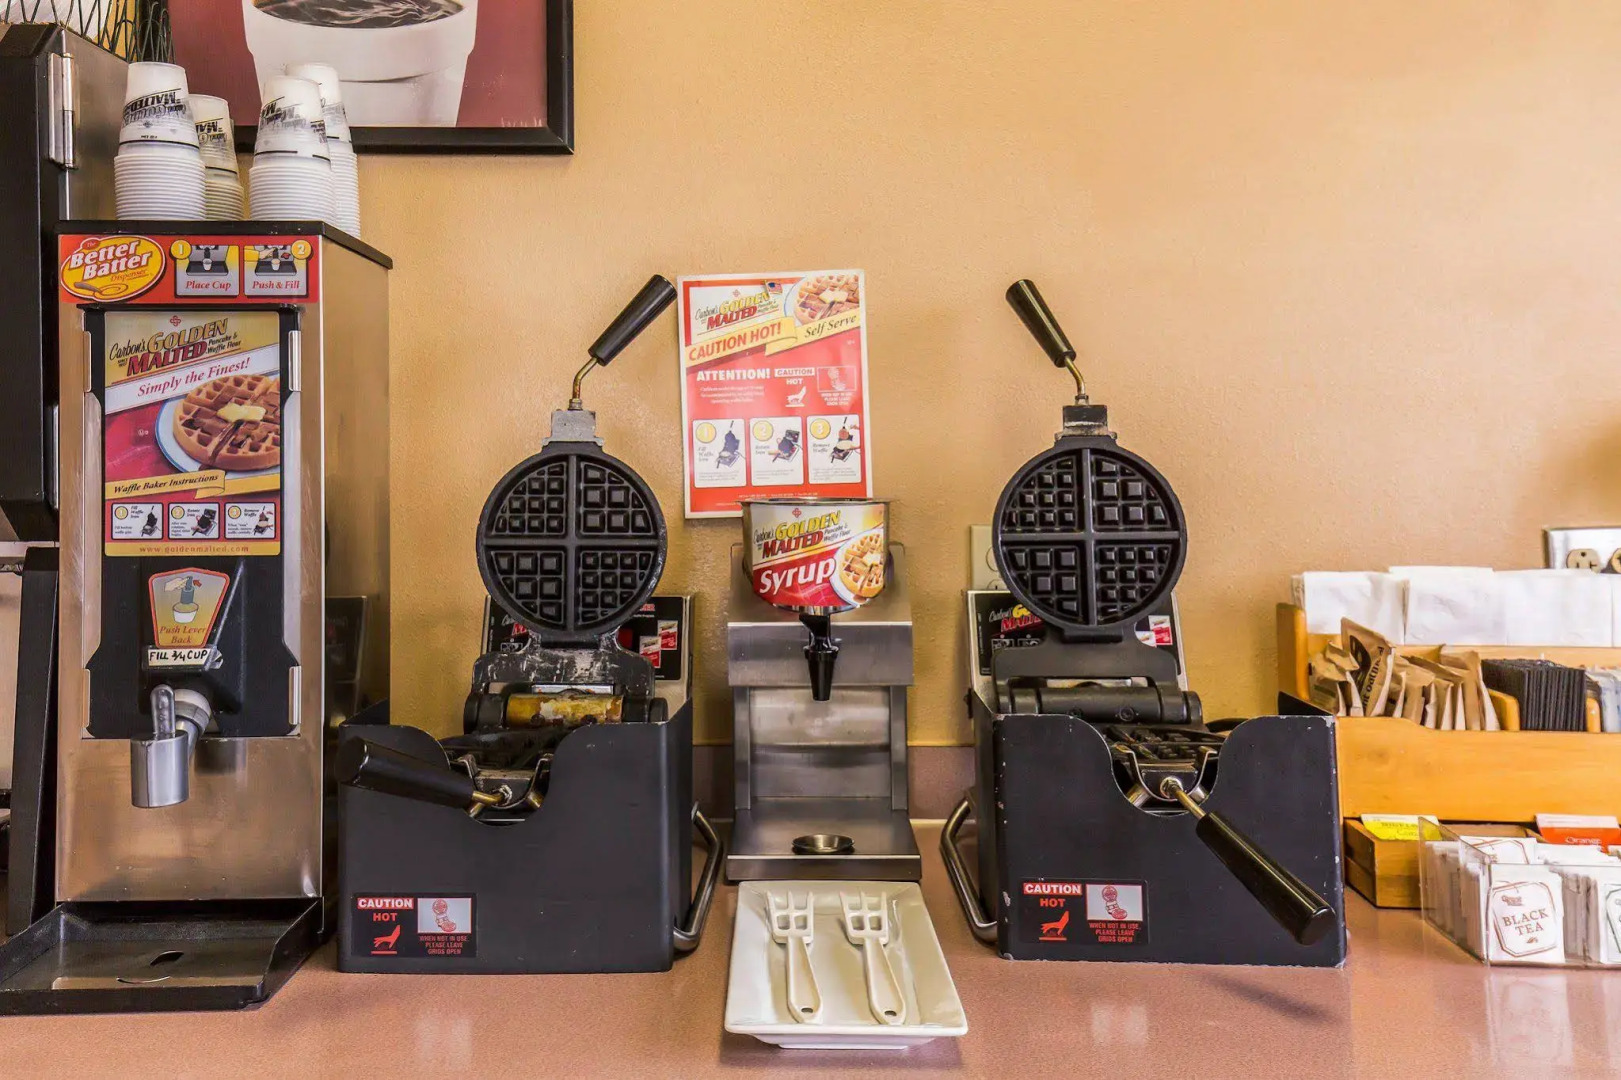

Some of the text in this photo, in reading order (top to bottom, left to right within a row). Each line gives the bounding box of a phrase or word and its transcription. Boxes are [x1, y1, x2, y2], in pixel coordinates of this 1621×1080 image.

[69, 240, 140, 270] Better
[178, 244, 184, 255] 1
[297, 244, 305, 255] 2
[83, 252, 152, 280] Batter
[111, 270, 146, 282] Dispenser
[252, 281, 274, 289] Push
[285, 281, 299, 289] Fill
[186, 281, 231, 291] Place Cup
[720, 292, 770, 315] GOLDEN
[707, 306, 757, 330] MALTED
[804, 314, 857, 338] Self Serve
[147, 318, 228, 354] GOLDEN
[689, 321, 781, 361] CAUTION HOT!
[127, 341, 208, 376] MALTED
[138, 357, 250, 396] Simply the Finest!
[696, 368, 770, 382] ATTENTION!
[114, 475, 218, 494] Waffle Baker Instructions
[776, 511, 841, 540] GOLDEN
[762, 531, 823, 559] MALTED
[760, 558, 836, 595] Syrup
[183, 626, 206, 634] Lever
[149, 652, 169, 661] FILL
[187, 650, 208, 659] CUP
[1025, 884, 1081, 894] CAUTION
[358, 899, 413, 908] CAUTION
[1040, 898, 1065, 908] HOT
[373, 913, 398, 921] HOT
[1502, 908, 1548, 926] BLACK
[1515, 922, 1544, 936] TEA
